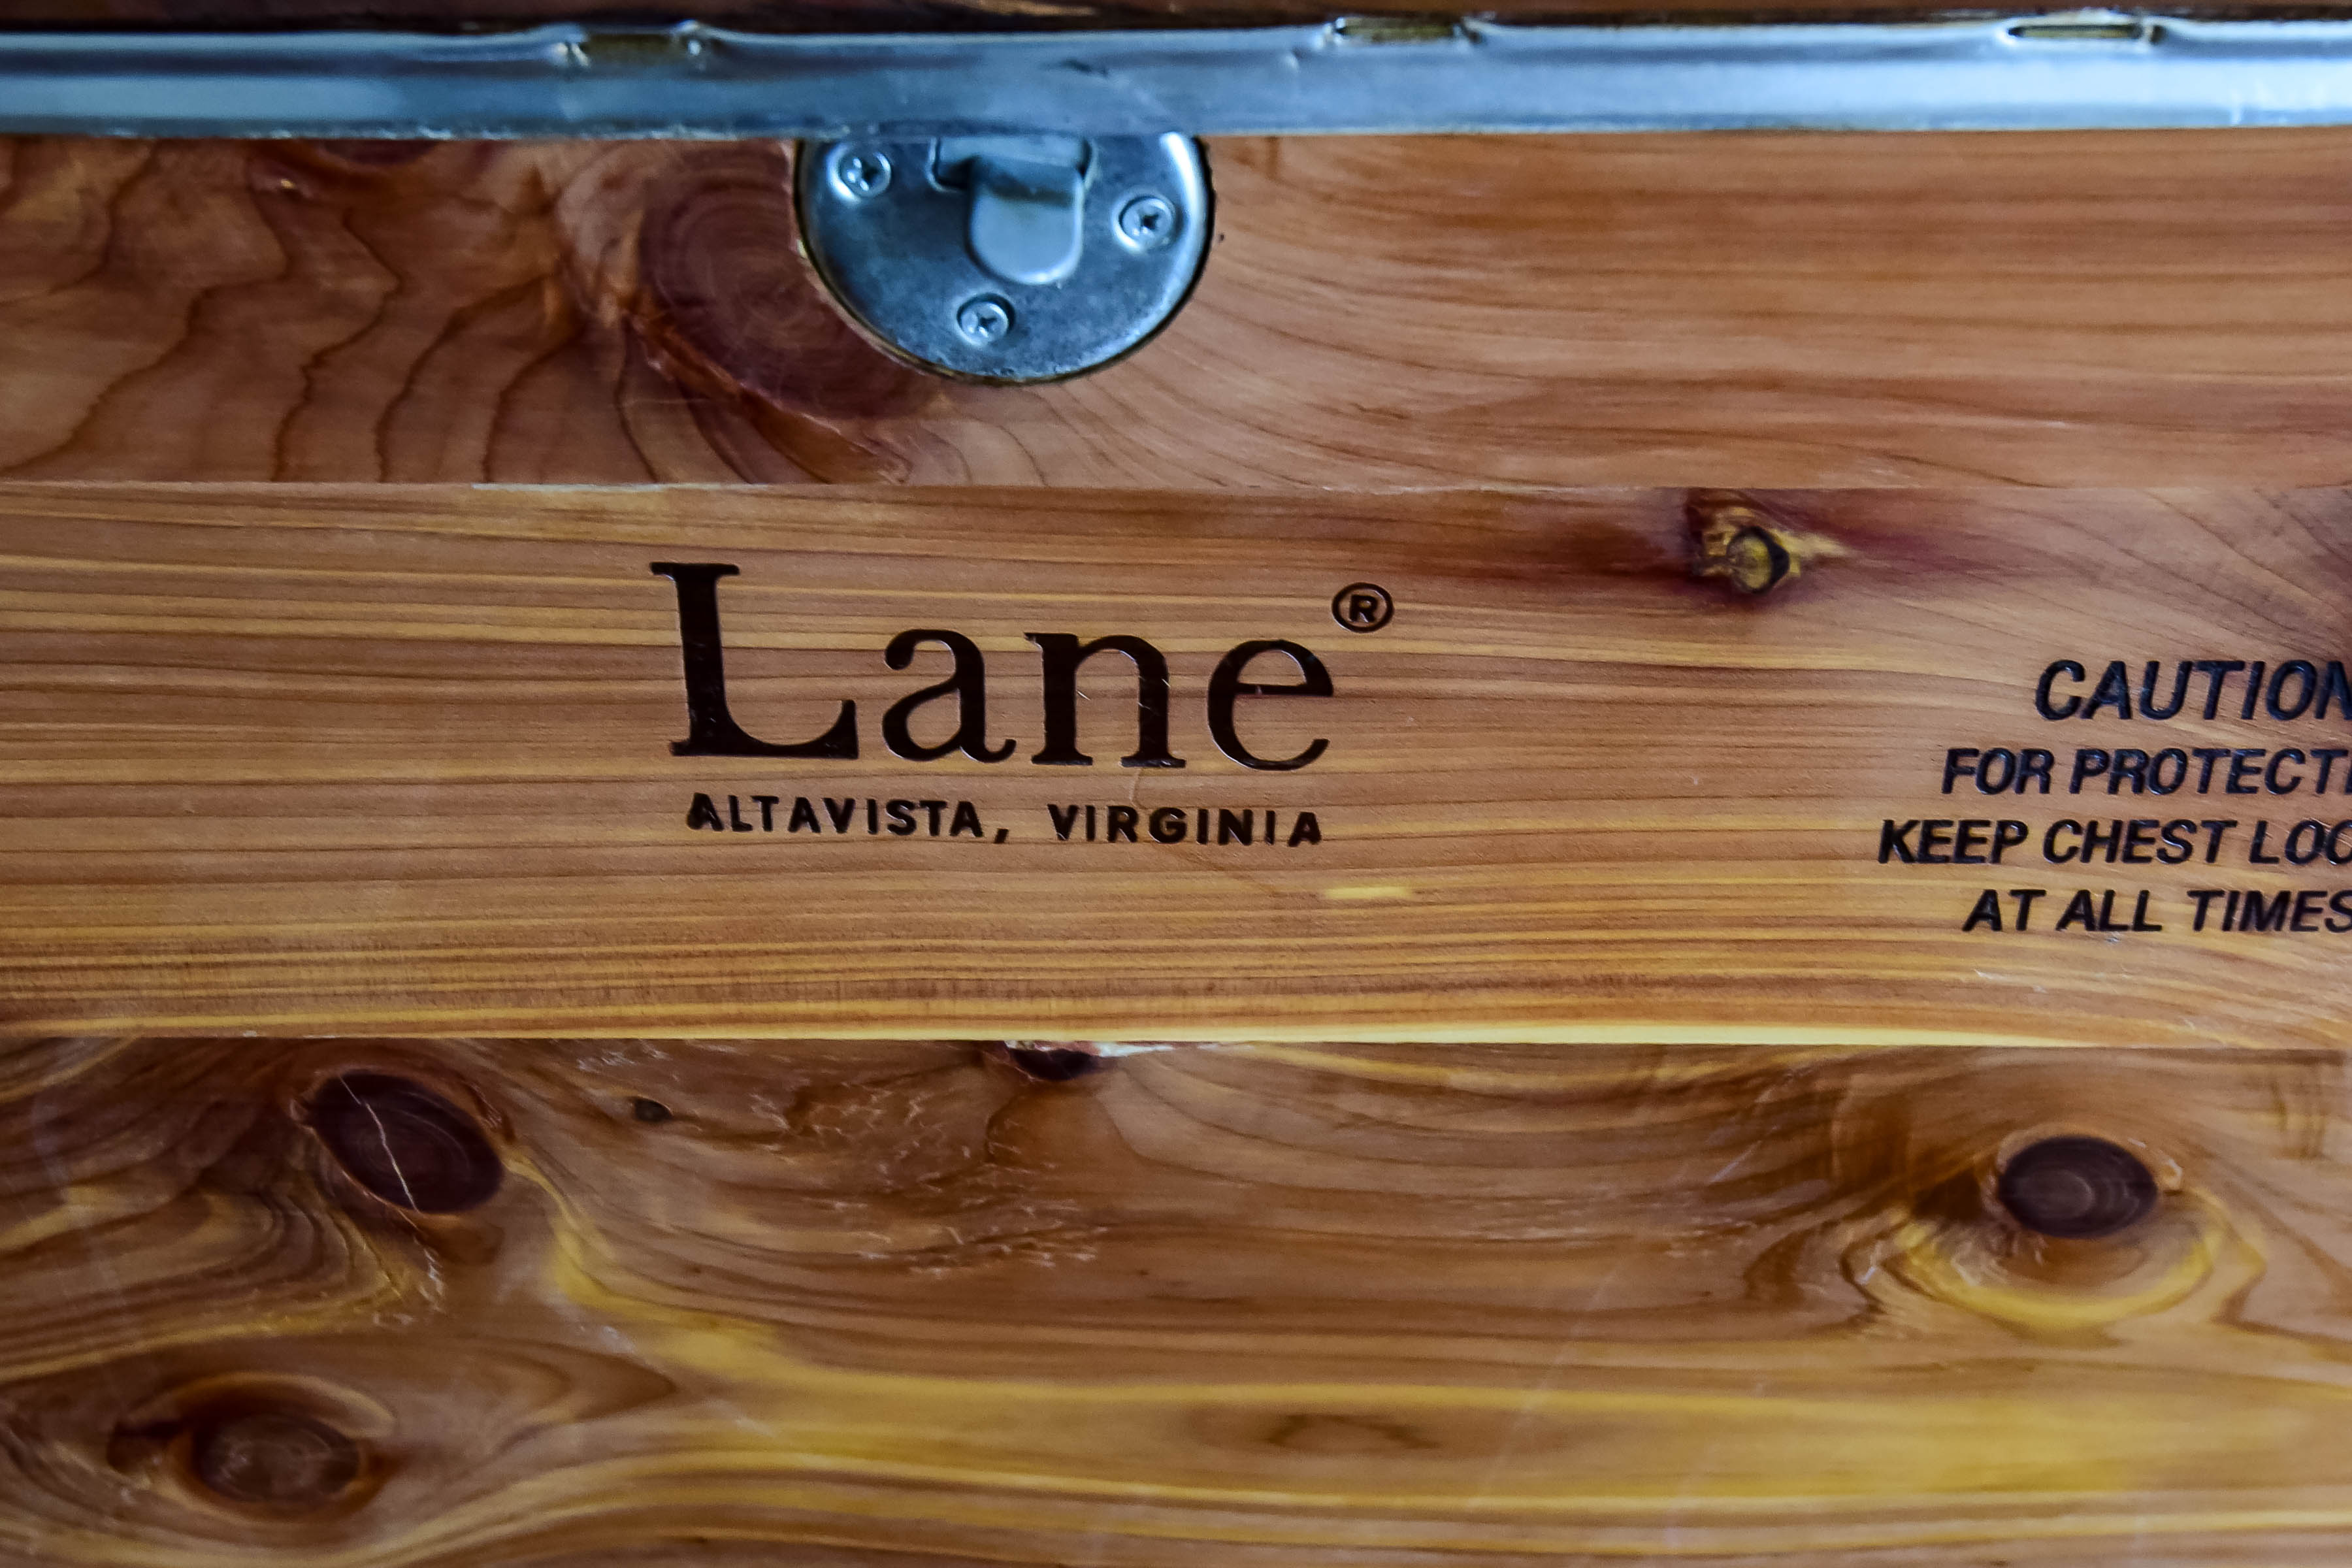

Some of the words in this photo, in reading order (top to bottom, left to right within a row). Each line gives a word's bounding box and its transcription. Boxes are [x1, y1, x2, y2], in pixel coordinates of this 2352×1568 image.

[2033, 657, 2352, 722] CAUTION
[1940, 747, 2056, 796] FOR
[2068, 747, 2352, 796] PROTECT
[685, 791, 1010, 845] ALTAVISTA,
[1046, 803, 1322, 848] VIRGINIA
[1877, 819, 2029, 865] KEEP
[2042, 818, 2239, 865] CHEST
[1961, 889, 2047, 933] AT
[2055, 889, 2163, 932] ALL
[2186, 889, 2352, 934] TIMES
